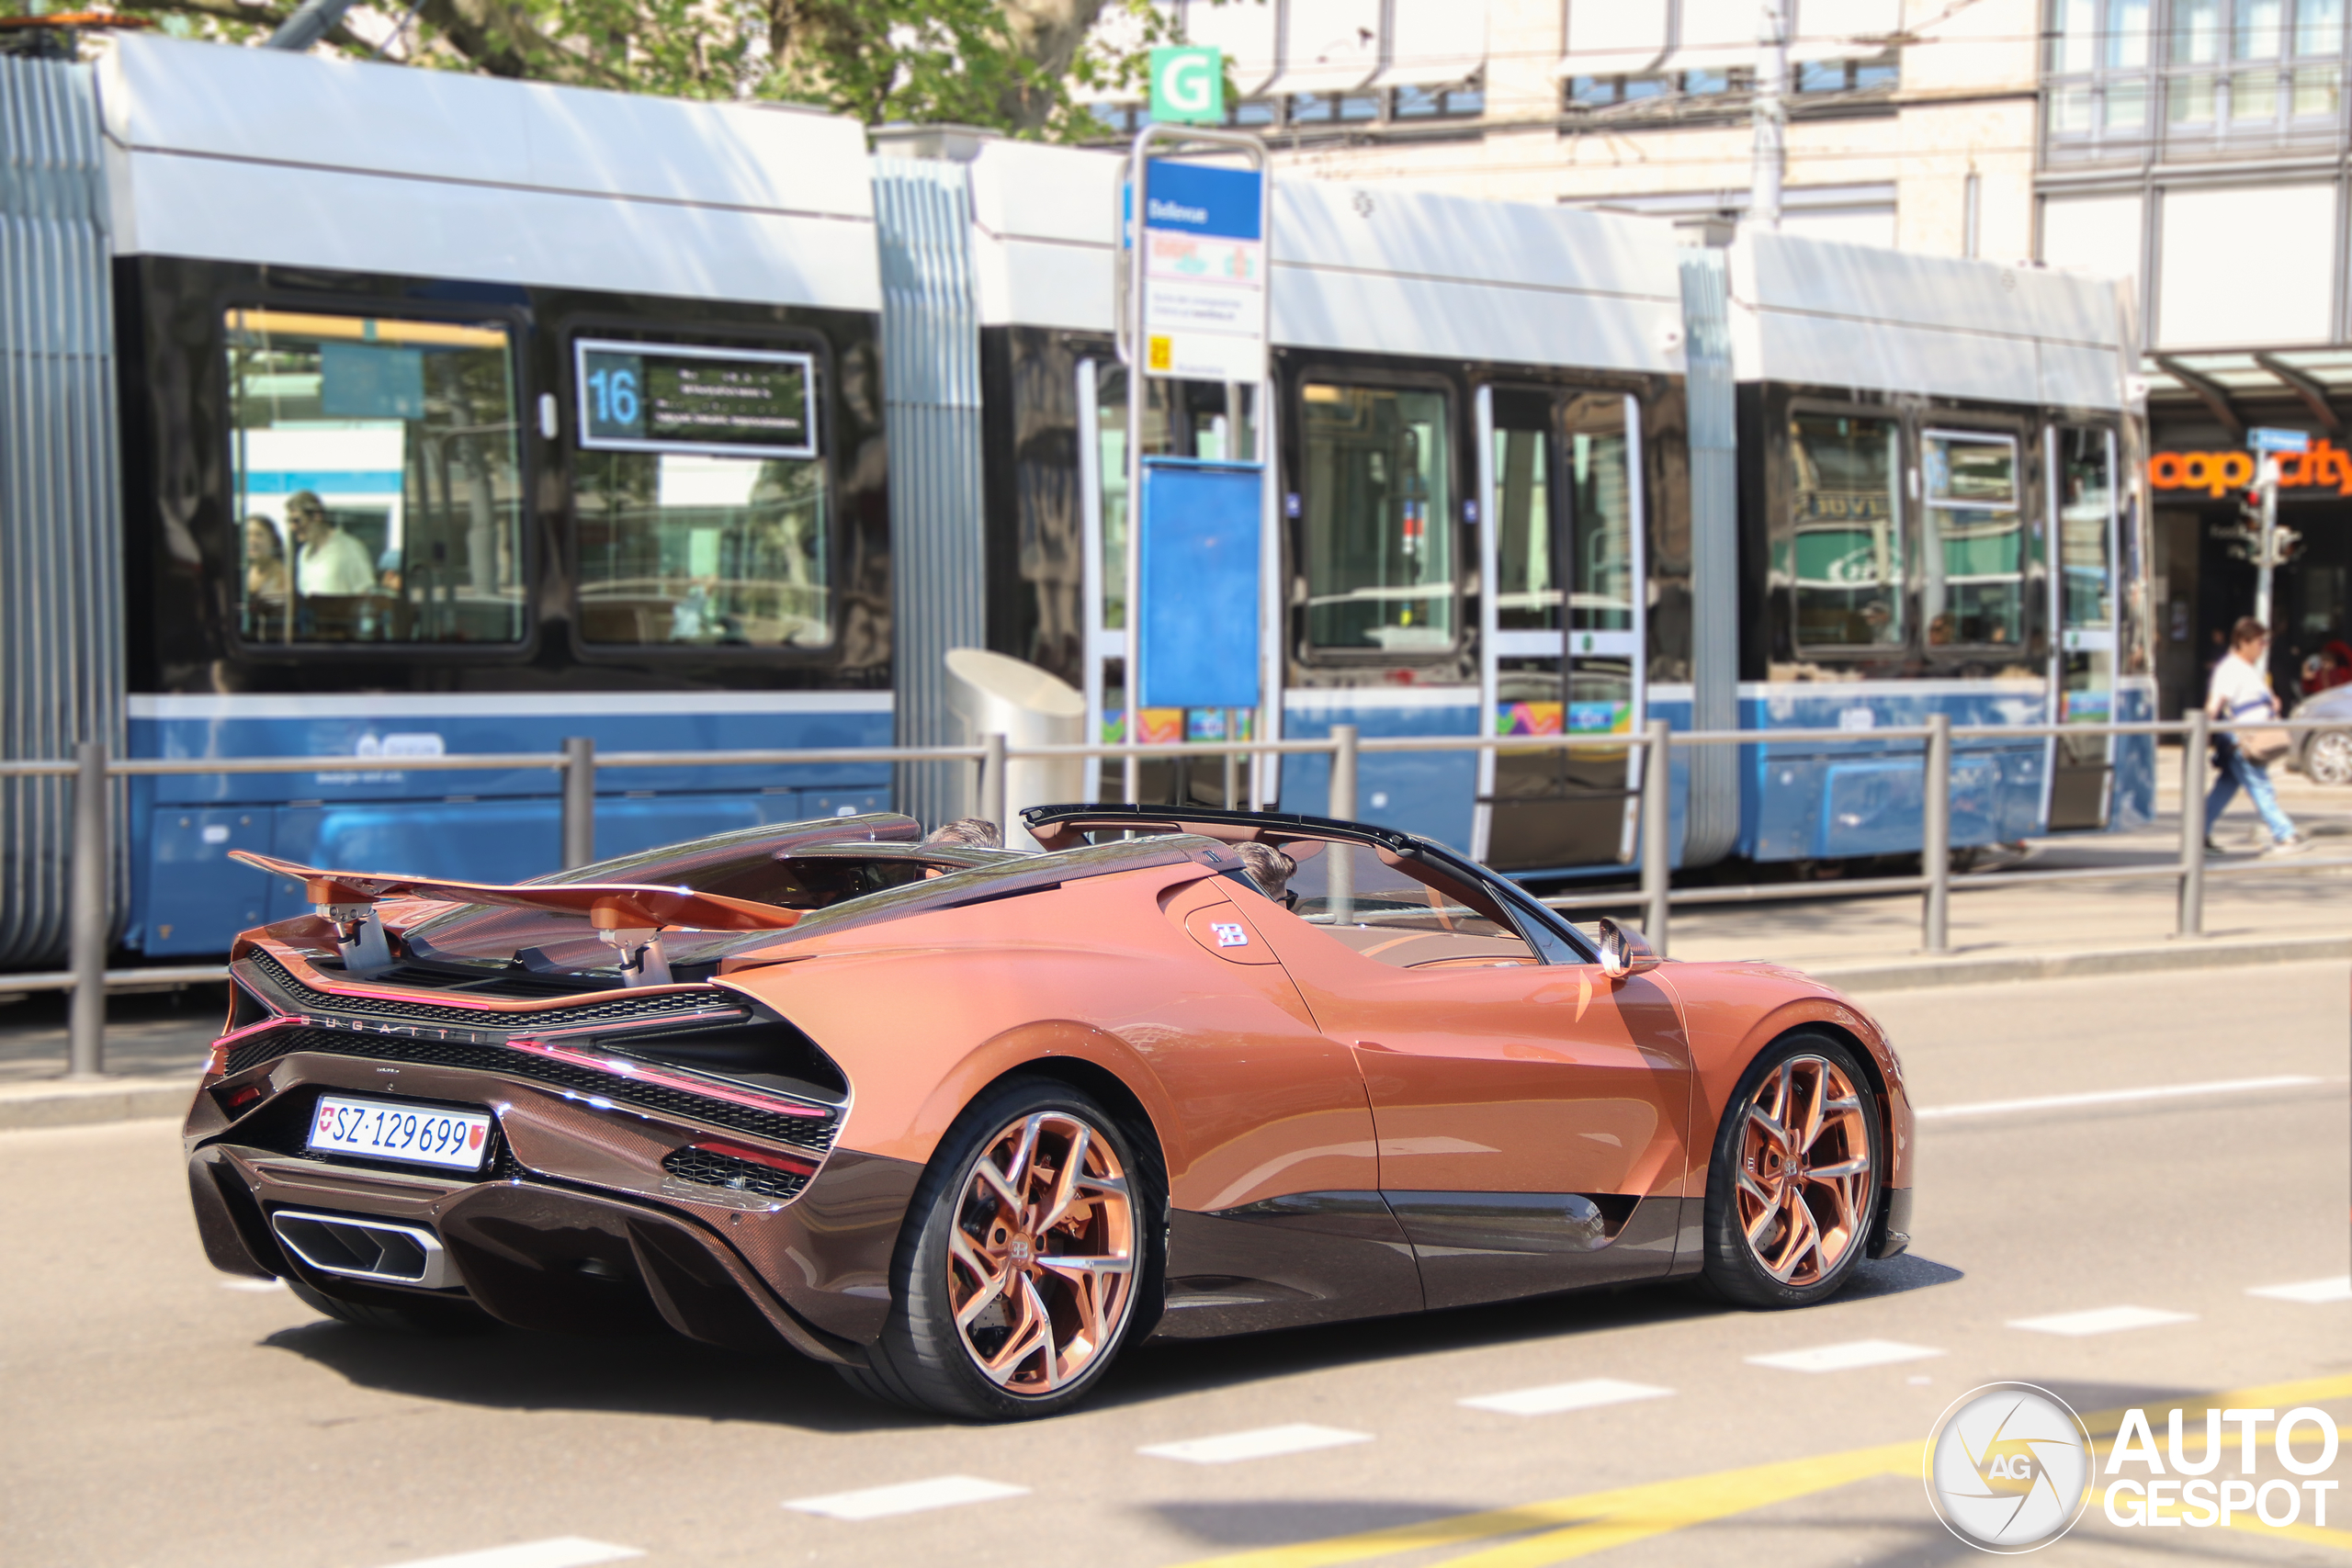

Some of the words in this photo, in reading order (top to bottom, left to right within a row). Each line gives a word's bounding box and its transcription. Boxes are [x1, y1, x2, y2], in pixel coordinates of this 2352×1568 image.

[1160, 53, 1212, 112] G
[588, 368, 639, 425] 16
[2148, 451, 2255, 498] oop
[300, 1014, 477, 1043] BUGATTI
